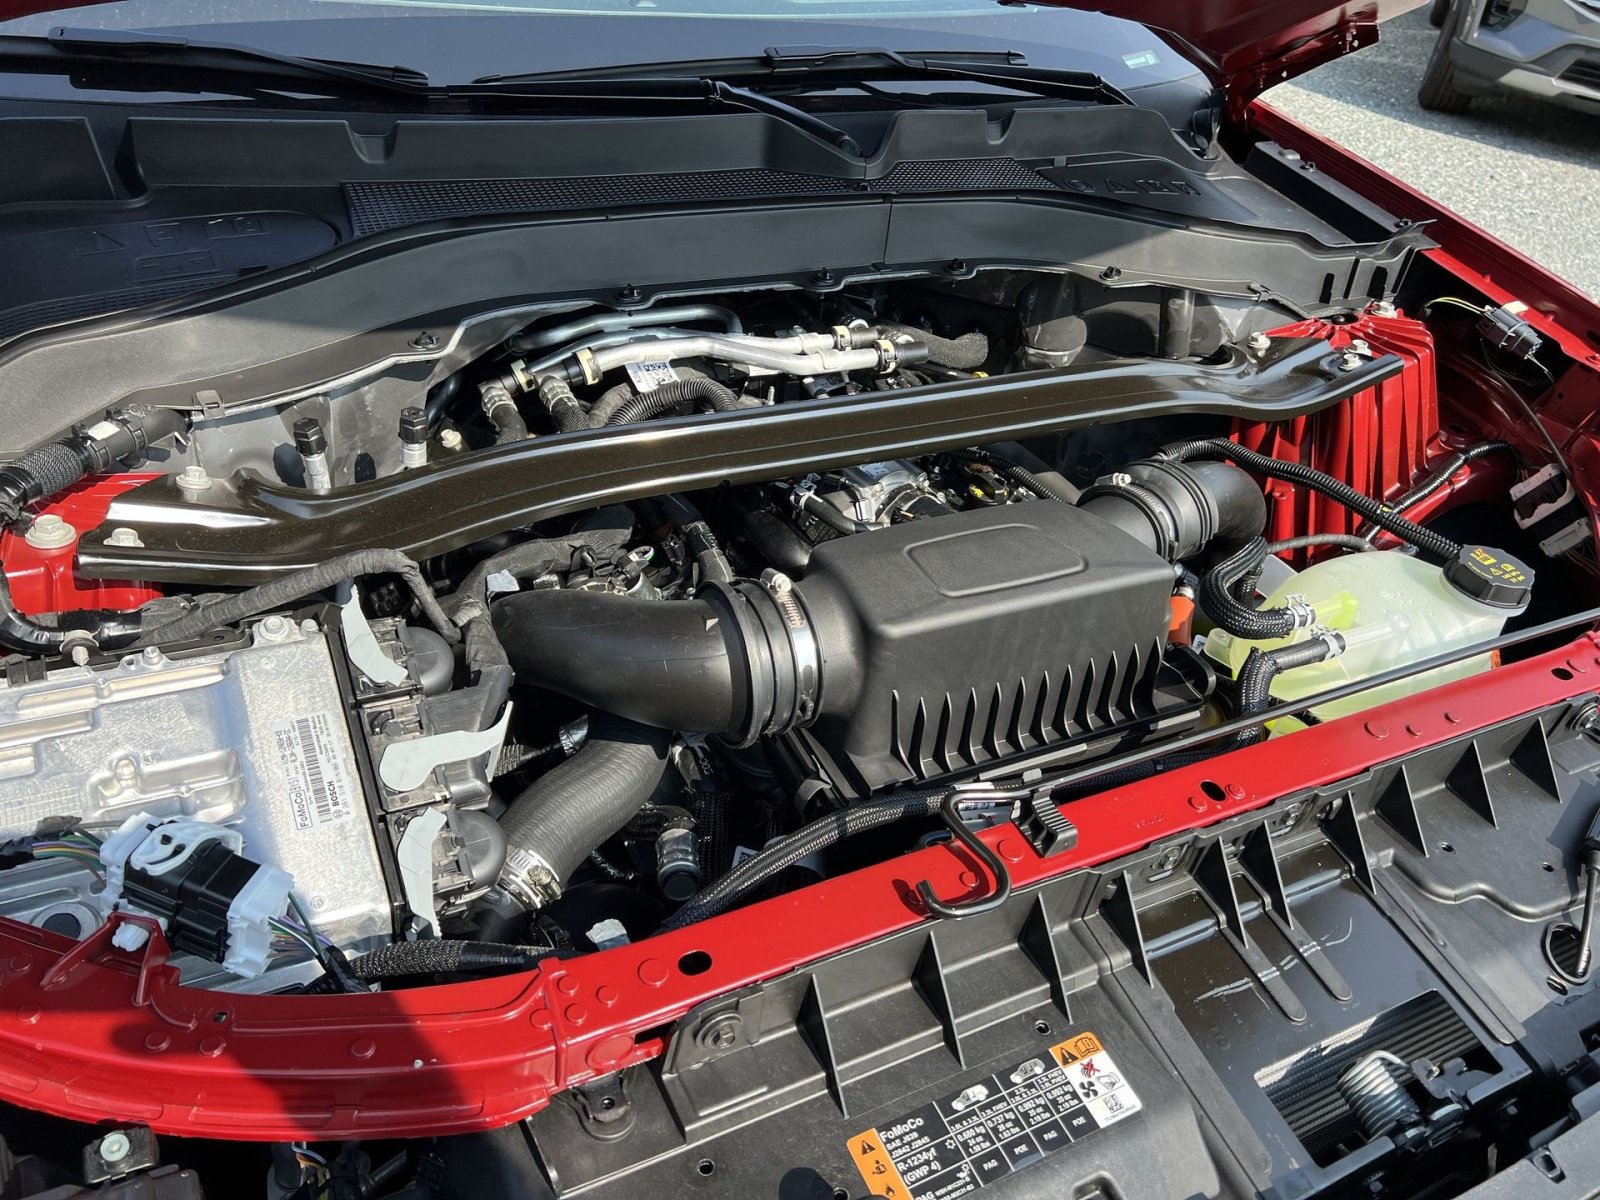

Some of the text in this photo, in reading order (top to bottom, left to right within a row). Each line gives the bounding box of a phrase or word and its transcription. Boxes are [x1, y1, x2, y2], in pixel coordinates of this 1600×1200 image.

[327, 781, 339, 807] BOSCH
[295, 793, 308, 828] FoMoCo
[1064, 1084, 1074, 1093] kg
[1036, 1096, 1045, 1107] kg
[1069, 1099, 1079, 1107] lbs
[987, 1111, 1015, 1127] 0.737 kg
[1041, 1112, 1051, 1120] lbs
[1072, 1116, 1086, 1126] POE
[879, 1117, 924, 1142] FoMoCo
[975, 1125, 986, 1136] kg
[1011, 1126, 1021, 1135] lbs
[1043, 1130, 1058, 1141] PAG
[886, 1138, 902, 1151] SAE
[892, 1136, 930, 1159] J2842 J2845
[981, 1140, 991, 1149] lbs
[1013, 1143, 1029, 1155] POE
[897, 1147, 937, 1172] R-1234yf
[983, 1159, 999, 1171] PAG
[903, 1160, 941, 1185] (GWP 4)
